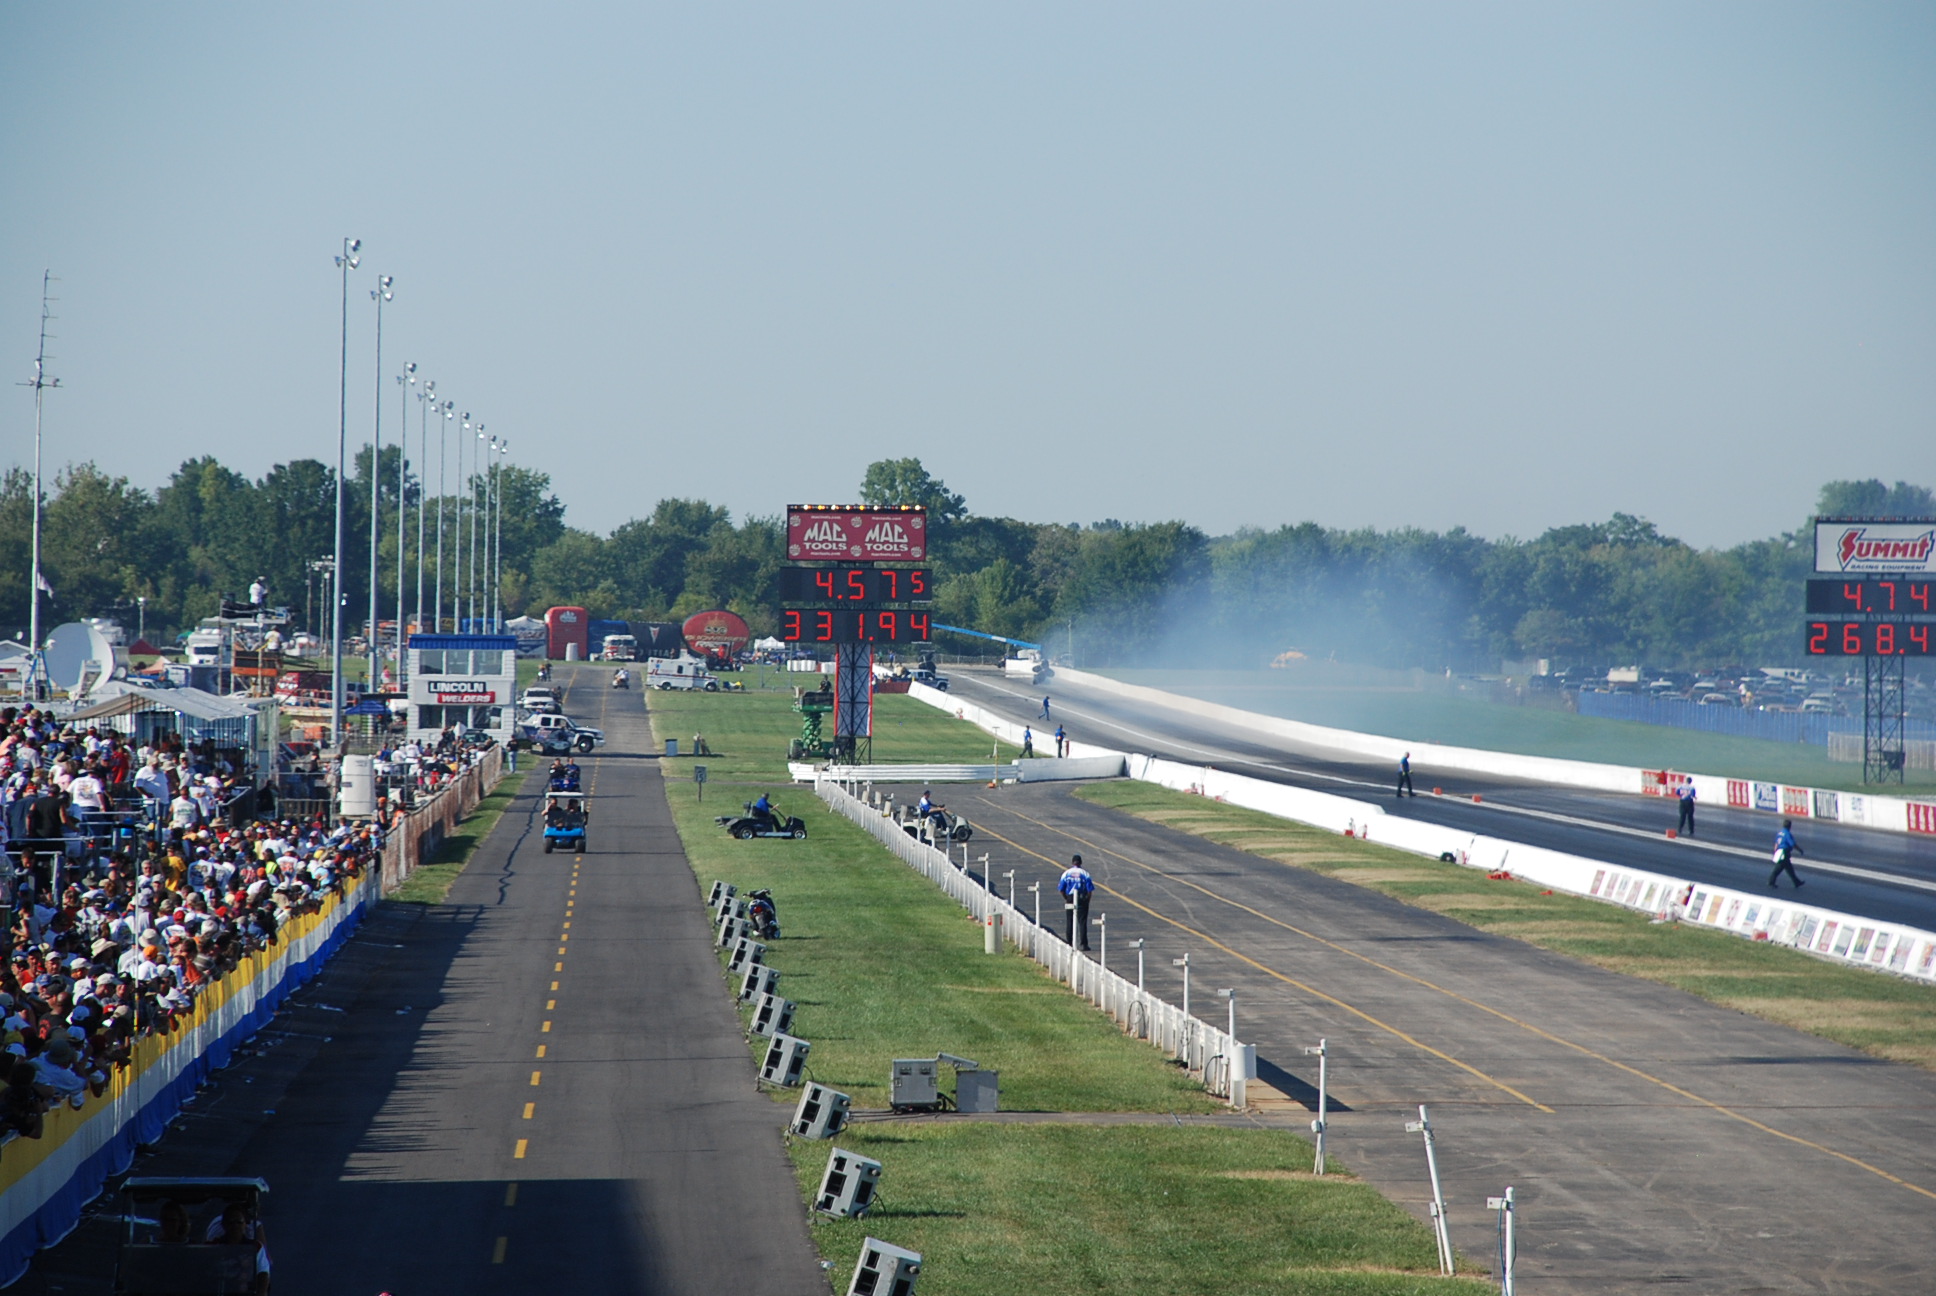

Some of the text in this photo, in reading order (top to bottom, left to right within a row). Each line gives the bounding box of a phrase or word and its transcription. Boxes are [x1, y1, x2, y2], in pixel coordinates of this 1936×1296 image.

[803, 521, 847, 542] MAC
[865, 521, 908, 543] MAC
[803, 542, 847, 551] TOOLS
[865, 543, 908, 552] TOOLS
[815, 570, 925, 600] 4.575
[1843, 582, 1928, 612] 4.74
[784, 611, 928, 641] 331.94
[1810, 623, 1928, 654] 268.4
[430, 682, 484, 692] LINCOLN
[441, 694, 491, 703] WELDERS
